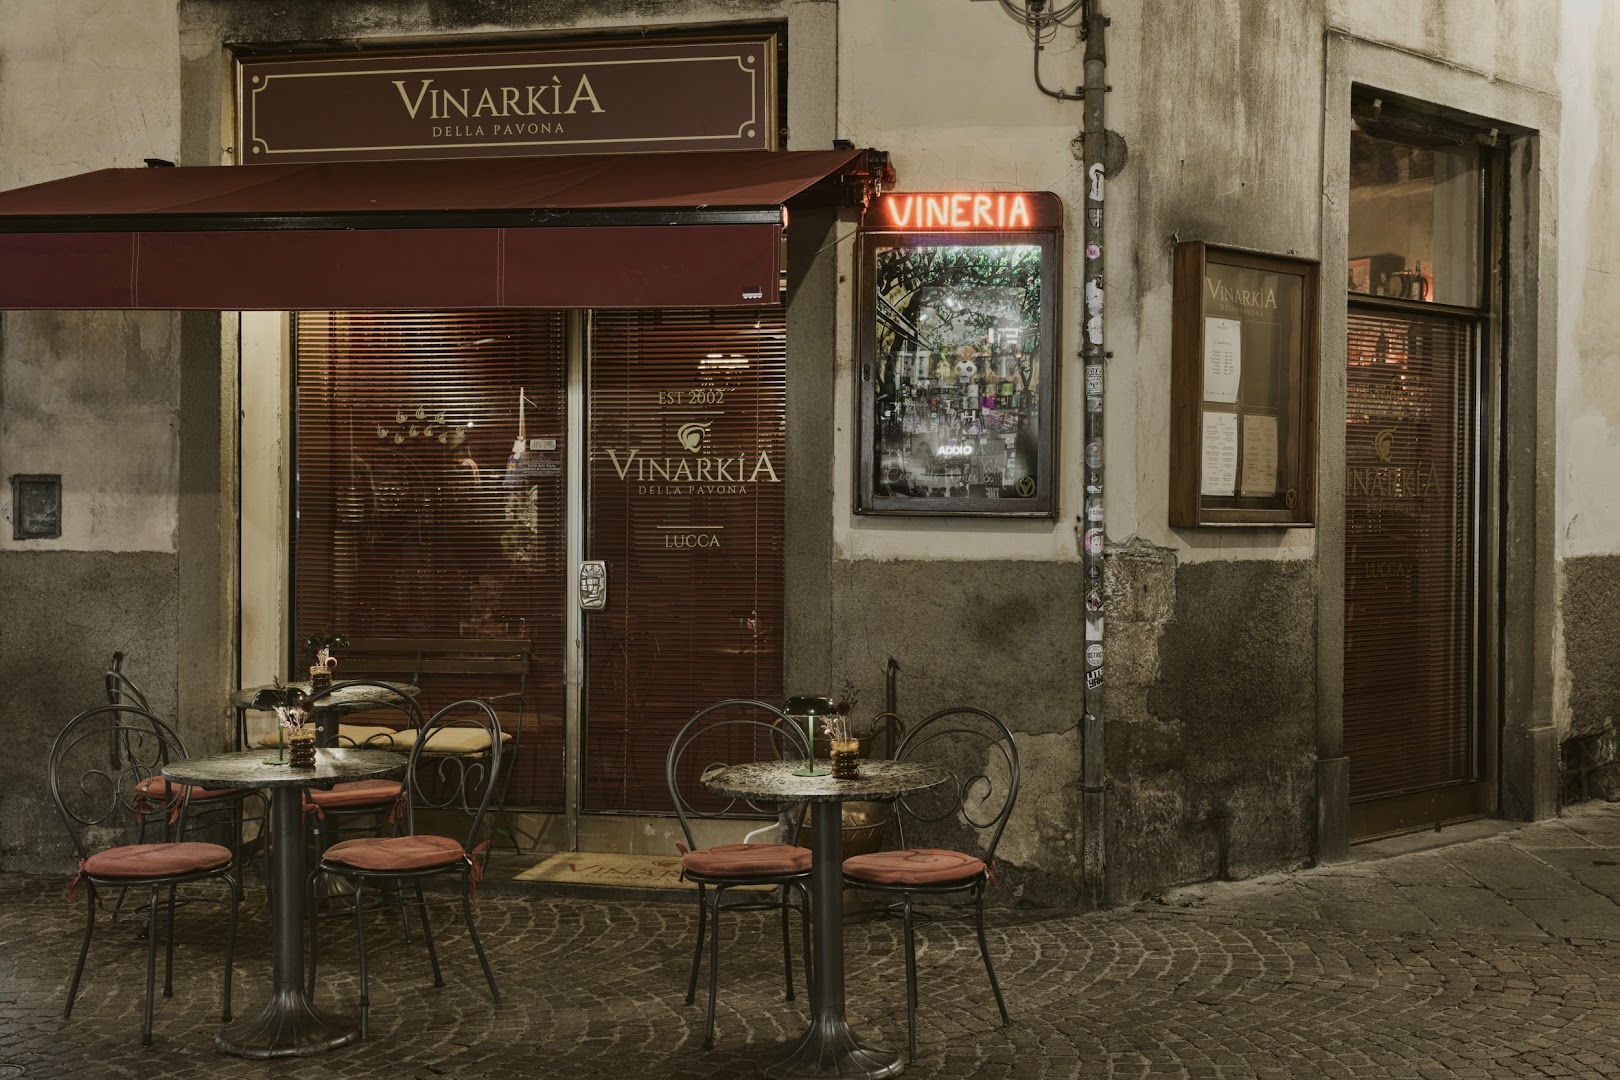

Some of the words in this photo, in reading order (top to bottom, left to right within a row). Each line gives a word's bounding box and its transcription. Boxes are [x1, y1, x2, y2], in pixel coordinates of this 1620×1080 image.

[392, 73, 605, 119] VINARKÌA
[432, 125, 484, 138] DELLA
[493, 122, 564, 136] PAVONA
[888, 195, 1030, 227] VINERIA
[658, 392, 684, 404] EST
[689, 391, 724, 405] 2002
[605, 449, 781, 483] VINARKÍA
[638, 486, 681, 495] DELLA
[689, 485, 747, 494] PAVONA
[1346, 461, 1442, 497] INARKÍA
[665, 535, 720, 548] LUCCA
